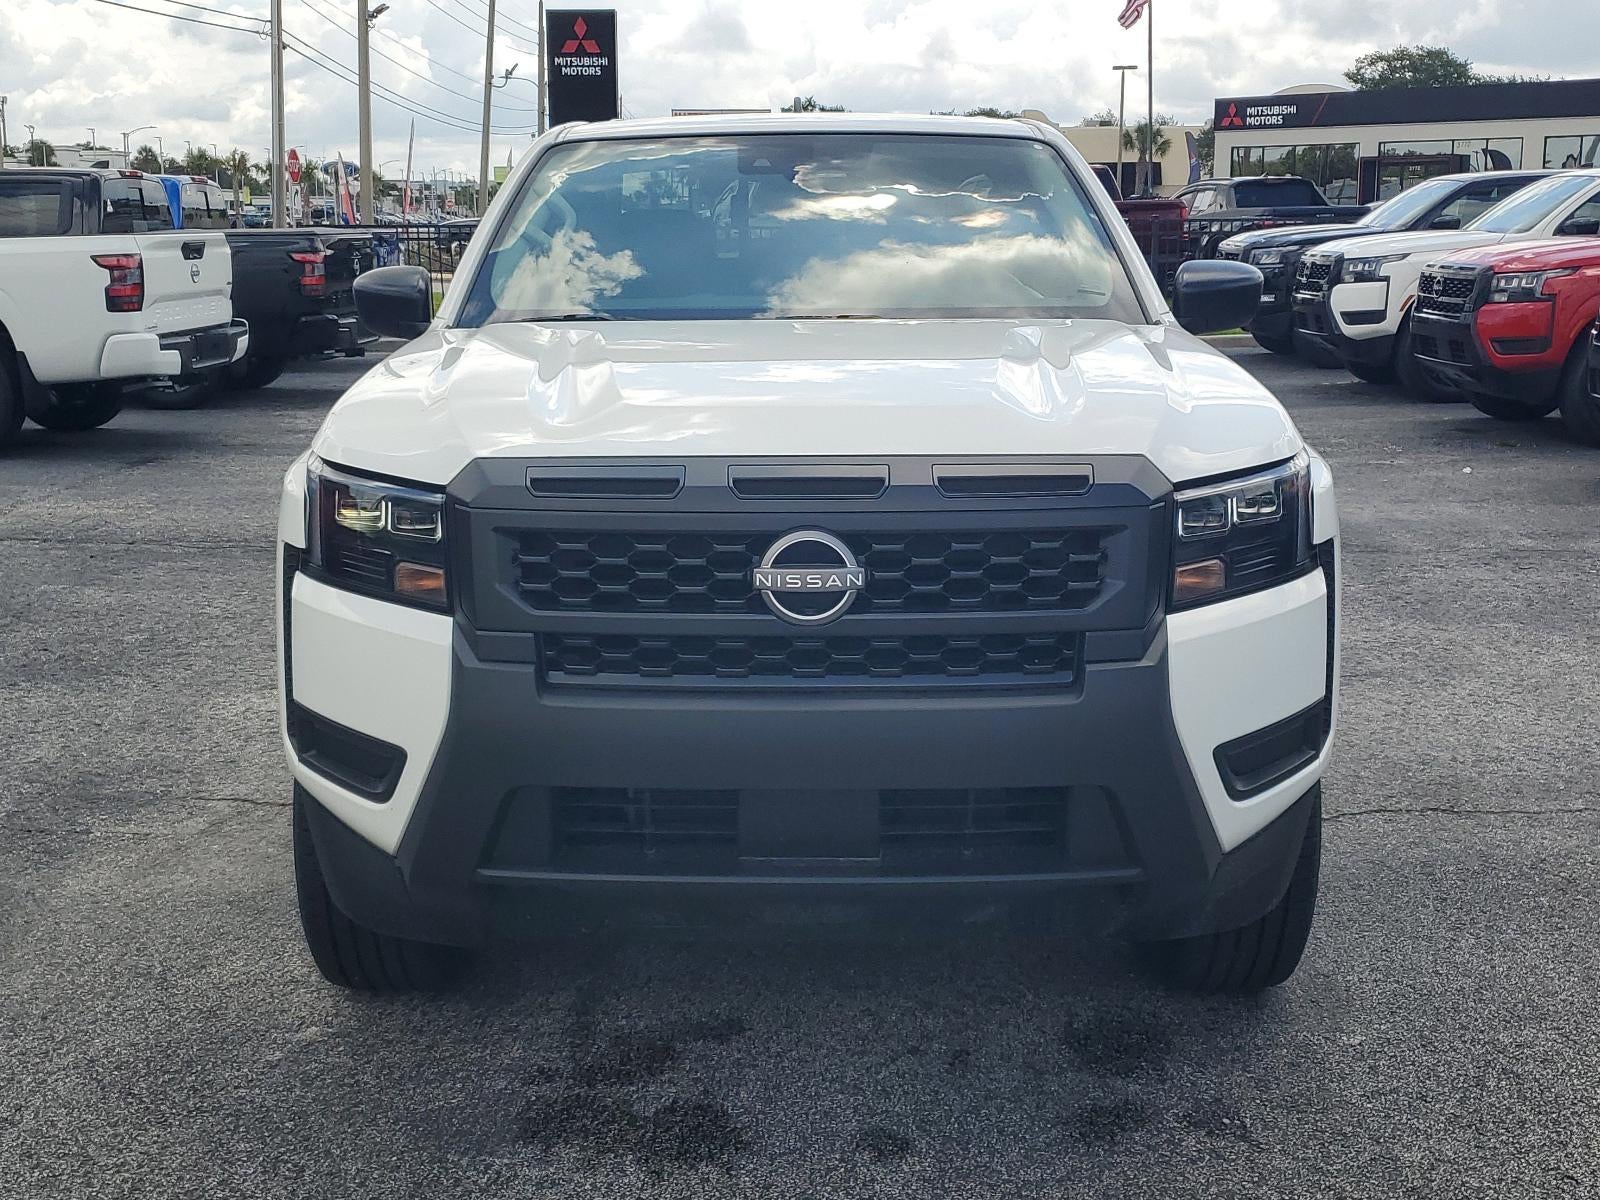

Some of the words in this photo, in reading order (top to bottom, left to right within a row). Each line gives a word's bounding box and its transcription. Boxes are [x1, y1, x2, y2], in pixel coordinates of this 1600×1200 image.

[554, 56, 608, 66] MITSUBISHI
[561, 66, 602, 76] MOTORS
[1246, 105, 1297, 116] MITSUBISHI
[1246, 116, 1283, 126] MOTORS
[288, 159, 300, 173] STOP
[755, 573, 863, 588] NISSAN
